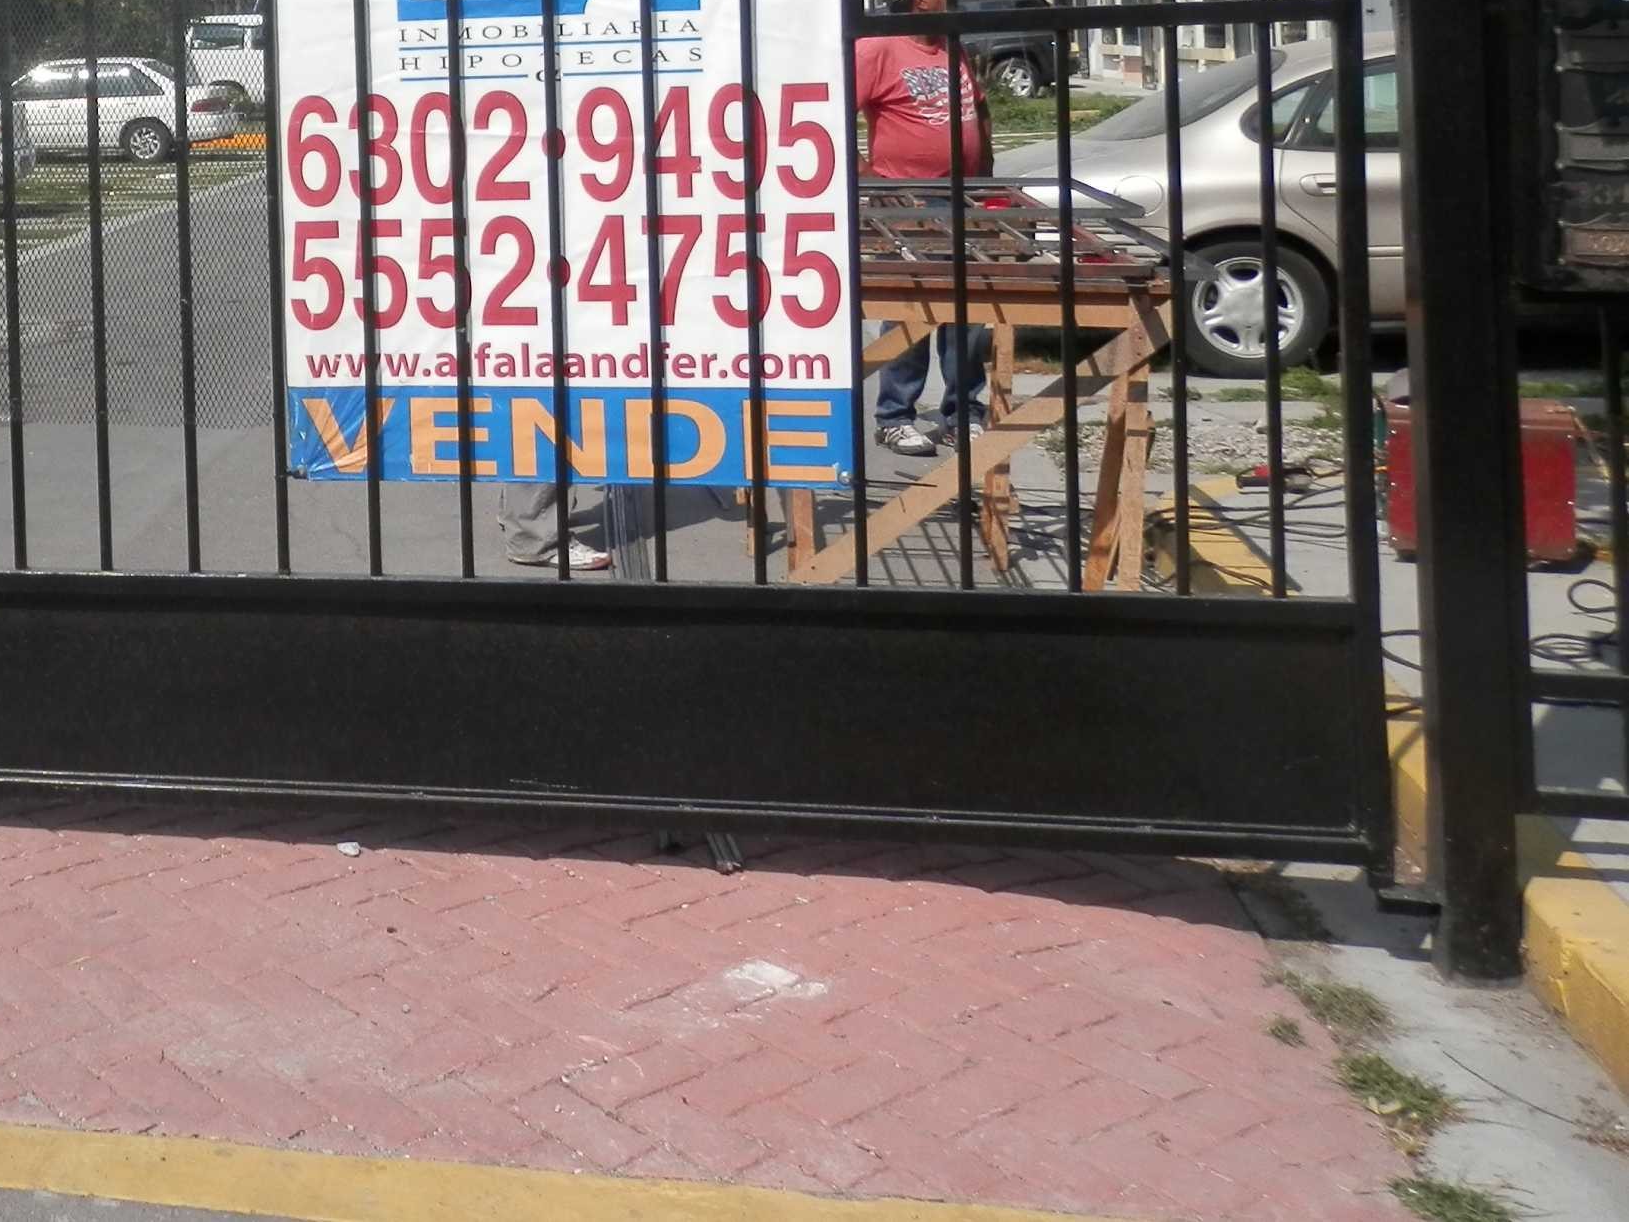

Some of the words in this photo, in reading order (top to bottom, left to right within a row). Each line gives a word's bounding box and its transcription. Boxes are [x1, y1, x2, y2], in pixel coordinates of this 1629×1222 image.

[399, 48, 703, 70] HIPOECAS
[306, 343, 831, 379] www.afalaandfer.com
[302, 397, 837, 482] VENDE
